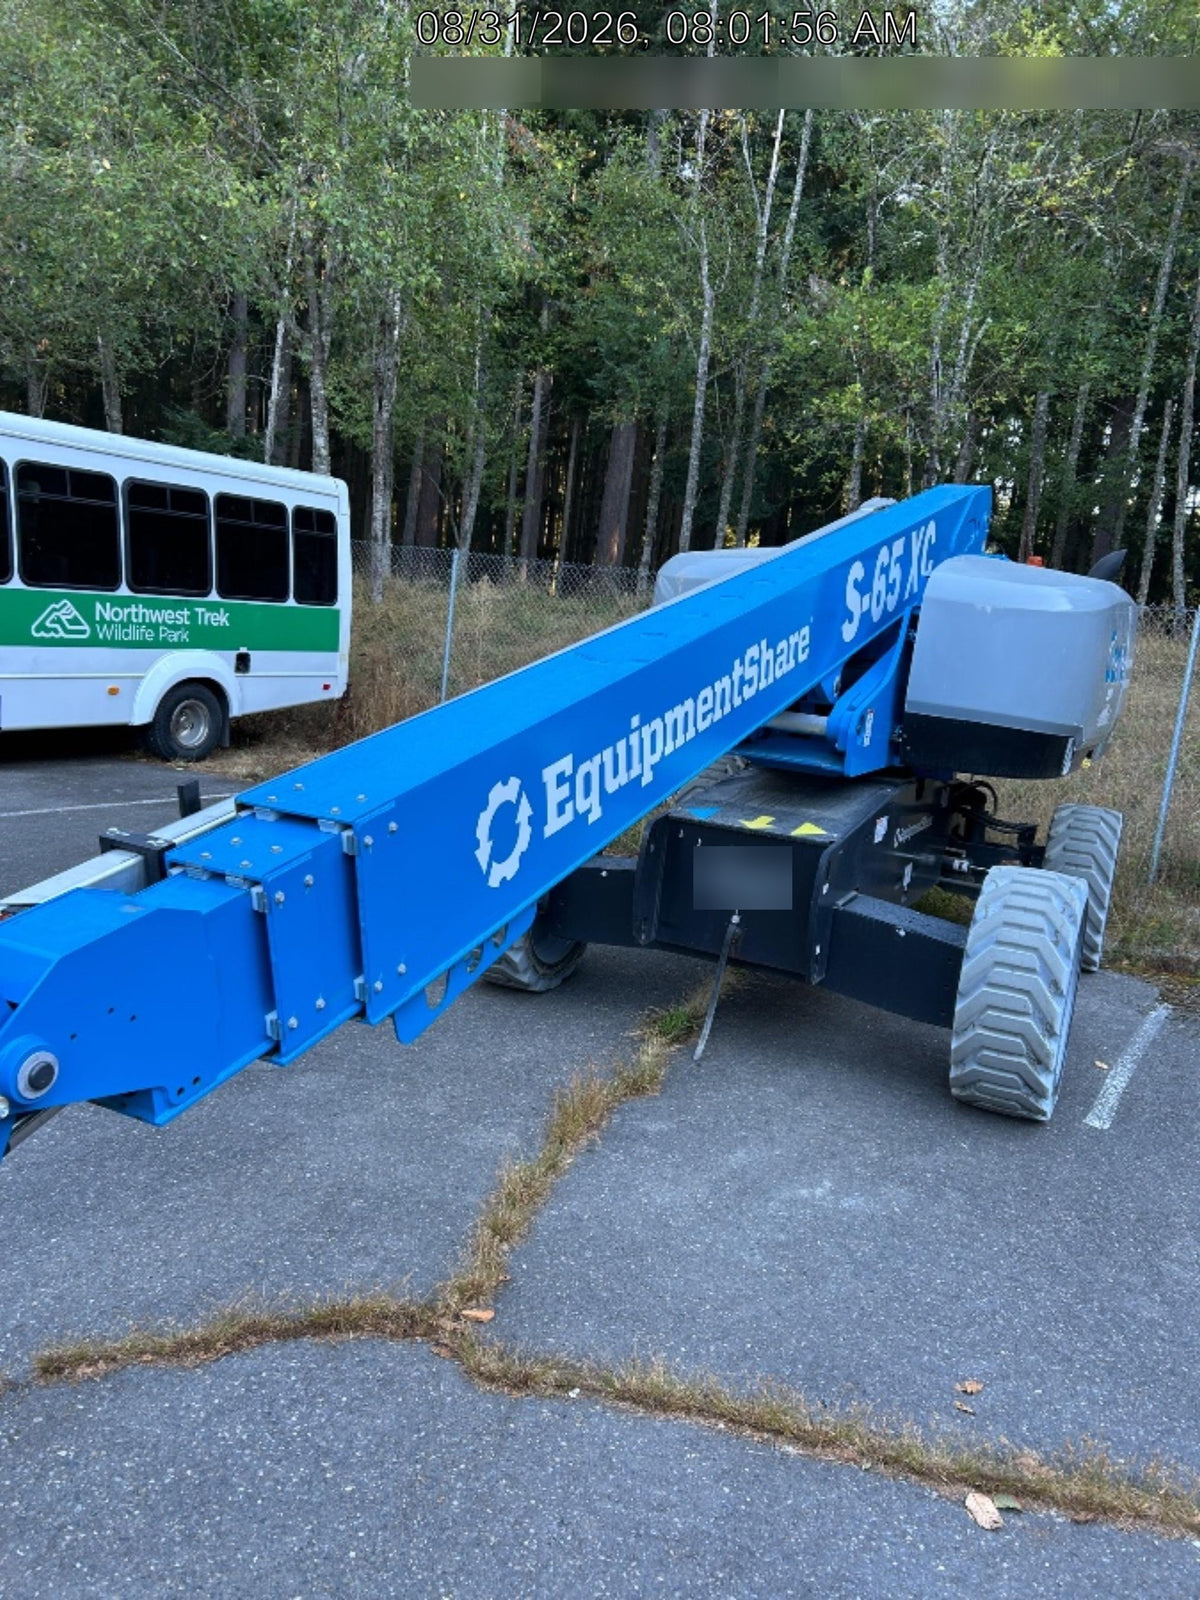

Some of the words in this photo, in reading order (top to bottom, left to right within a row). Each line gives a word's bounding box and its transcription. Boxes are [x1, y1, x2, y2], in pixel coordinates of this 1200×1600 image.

[95, 601, 190, 625] Northwest
[194, 607, 230, 627] Trek
[842, 535, 906, 643] S-65
[903, 519, 936, 601] XC
[96, 623, 155, 641] Wildlife
[159, 626, 190, 643] Park
[541, 625, 810, 840] EquipmentShare
